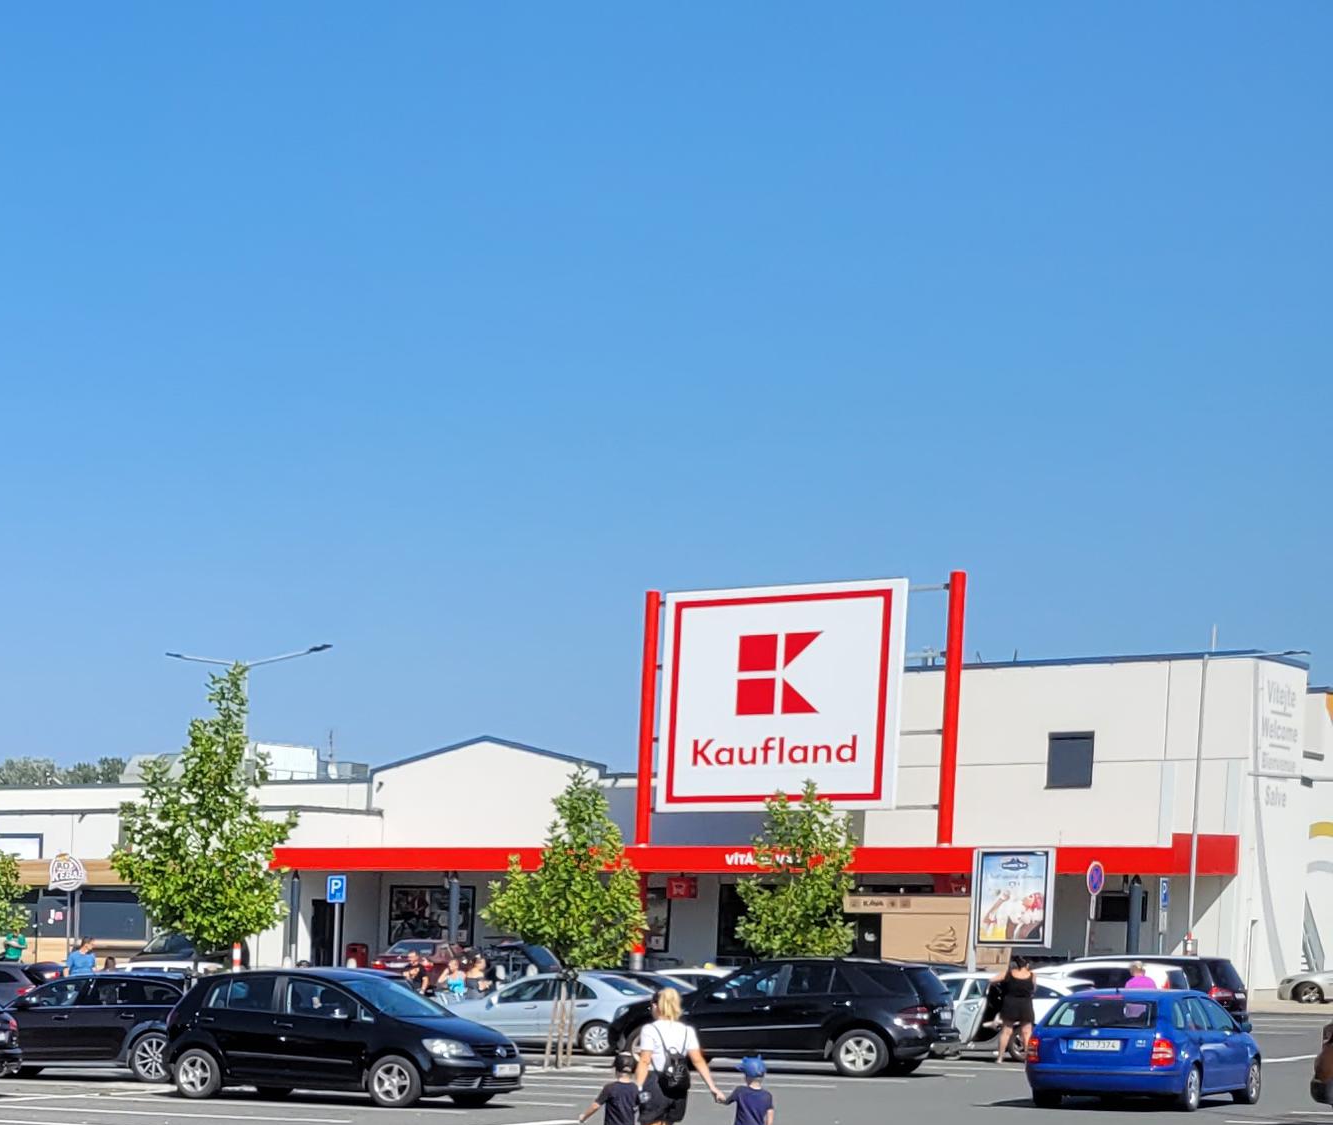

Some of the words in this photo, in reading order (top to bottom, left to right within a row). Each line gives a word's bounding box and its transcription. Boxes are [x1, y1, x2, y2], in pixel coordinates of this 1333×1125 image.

[1261, 716, 1298, 743] Welcome
[691, 735, 858, 767] Kaufland
[1264, 785, 1287, 808] Salve
[331, 879, 342, 895] P
